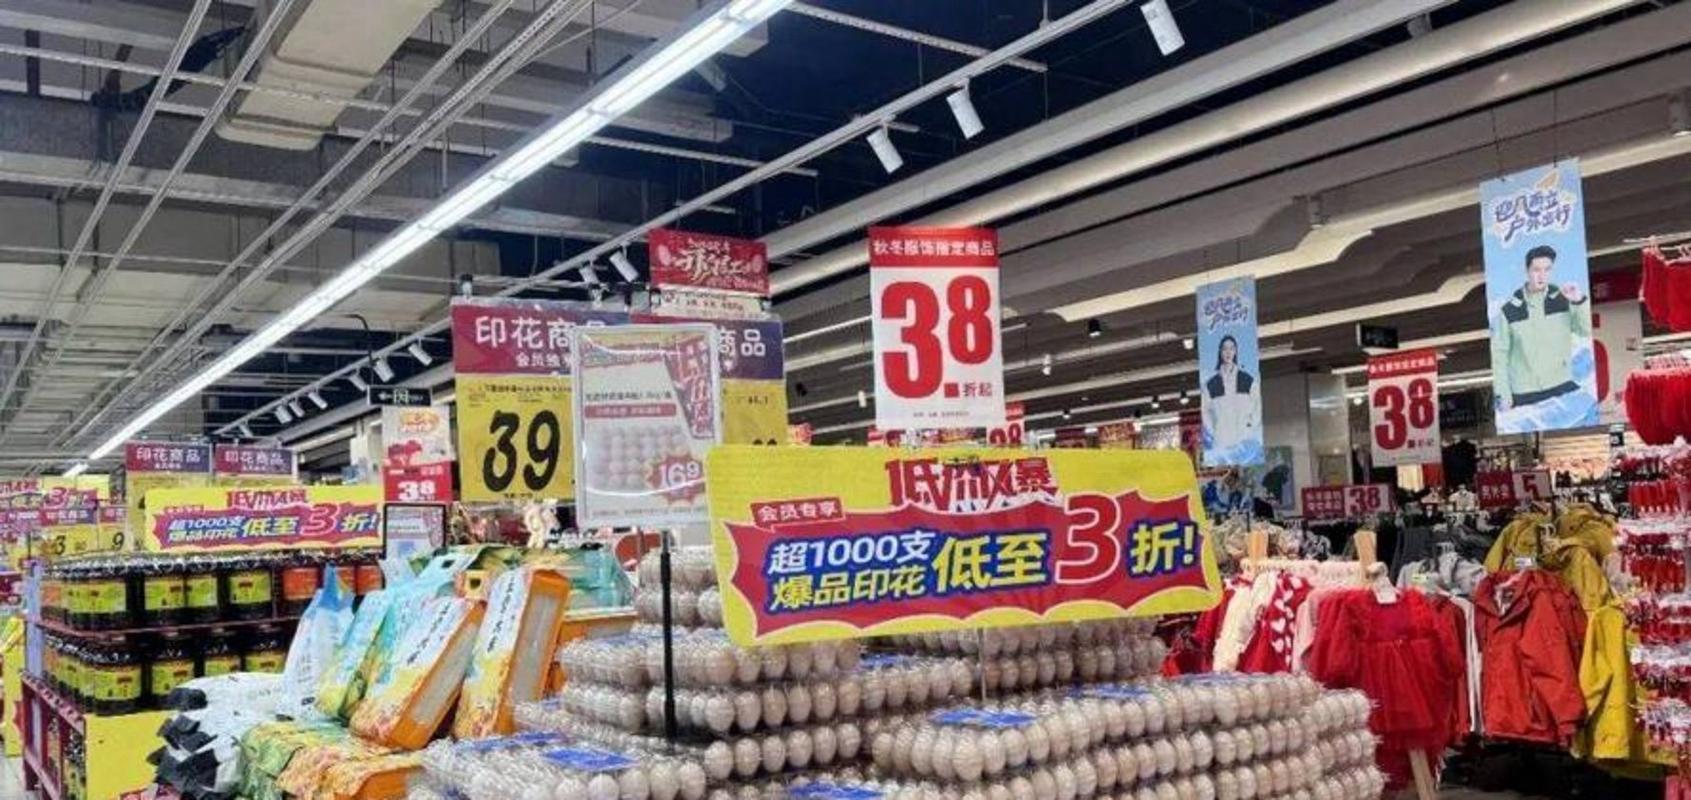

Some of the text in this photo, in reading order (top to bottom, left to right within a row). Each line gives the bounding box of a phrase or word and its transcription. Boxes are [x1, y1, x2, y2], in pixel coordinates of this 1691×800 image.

[1504, 204, 1571, 241] 户外出行
[872, 239, 995, 256] 秋冬服饰指定商品
[475, 315, 606, 349] 印花商
[962, 382, 993, 398] 折起
[136, 447, 201, 463] 印花商品
[483, 409, 561, 492] 39
[757, 501, 838, 522] 会员专享
[768, 530, 936, 575] 超1000支
[769, 565, 927, 611] 爆品印花
